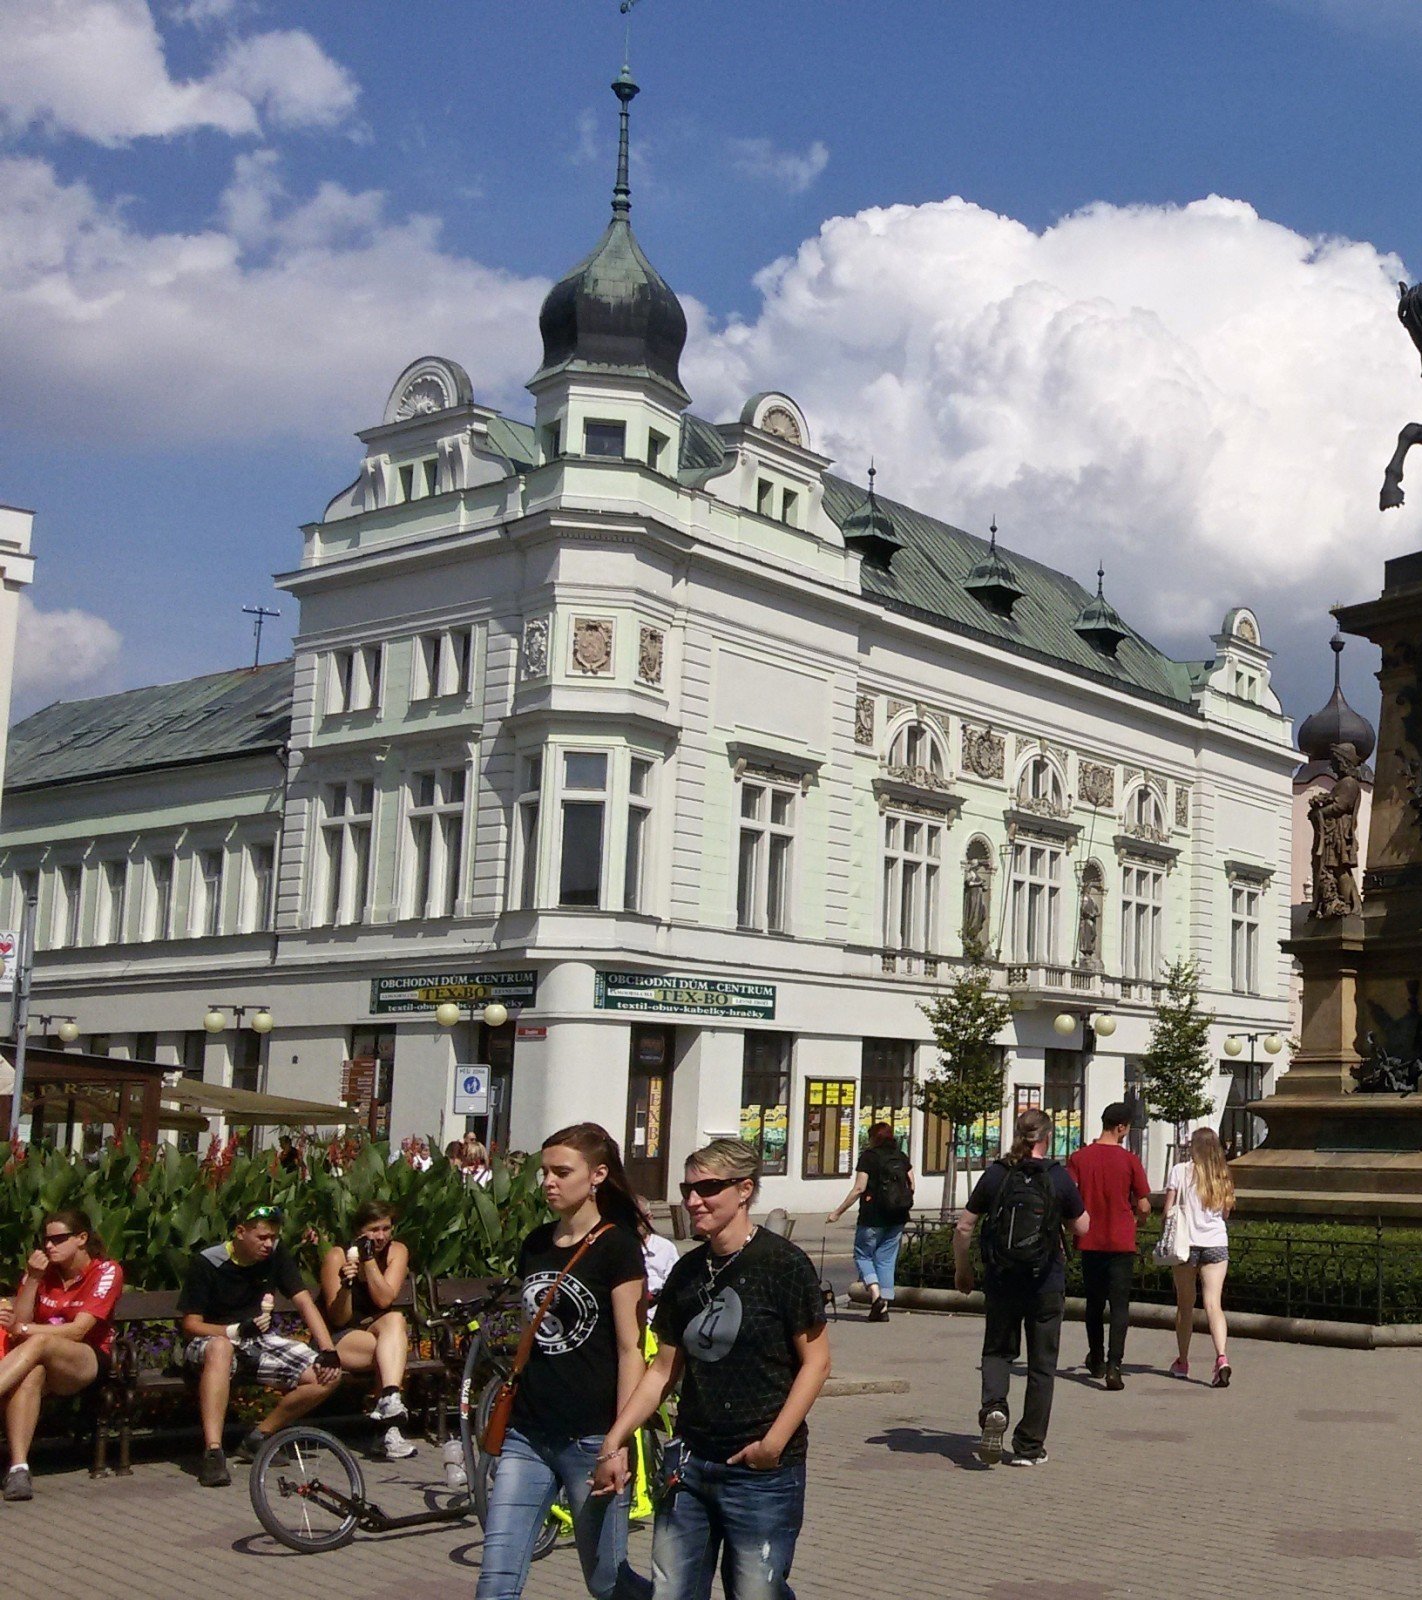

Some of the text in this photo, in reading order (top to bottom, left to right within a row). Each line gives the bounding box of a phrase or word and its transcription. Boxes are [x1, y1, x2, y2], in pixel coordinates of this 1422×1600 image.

[380, 975, 438, 989] OBCHODNÍ
[441, 973, 468, 986] DŮM
[475, 972, 534, 984] CENTRUM
[608, 974, 677, 988] OBCHODNÍ
[679, 978, 708, 991] DŮM
[717, 983, 773, 996] CENTRUM
[658, 990, 729, 1005] TEX-BO
